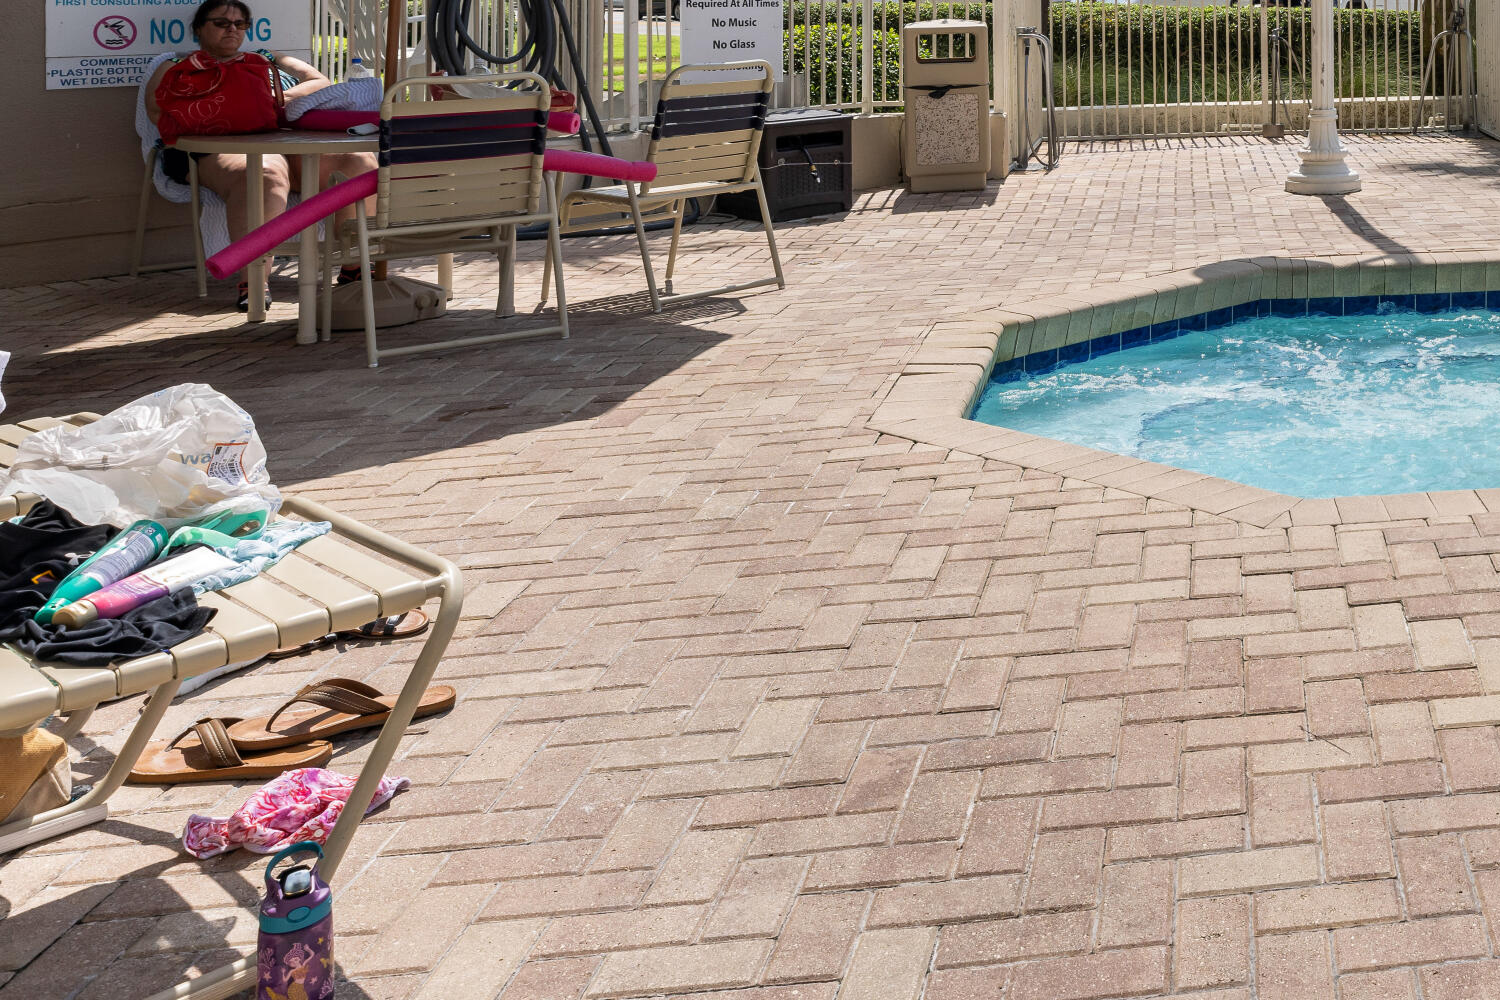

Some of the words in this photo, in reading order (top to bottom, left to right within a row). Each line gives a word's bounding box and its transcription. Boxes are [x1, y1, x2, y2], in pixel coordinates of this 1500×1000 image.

[686, 0, 728, 9] Required
[712, 18, 726, 27] No
[729, 18, 757, 27] Music
[150, 18, 184, 44] NO
[713, 40, 727, 49] No
[730, 40, 755, 48] Glass
[51, 68, 103, 77] PLASTIC
